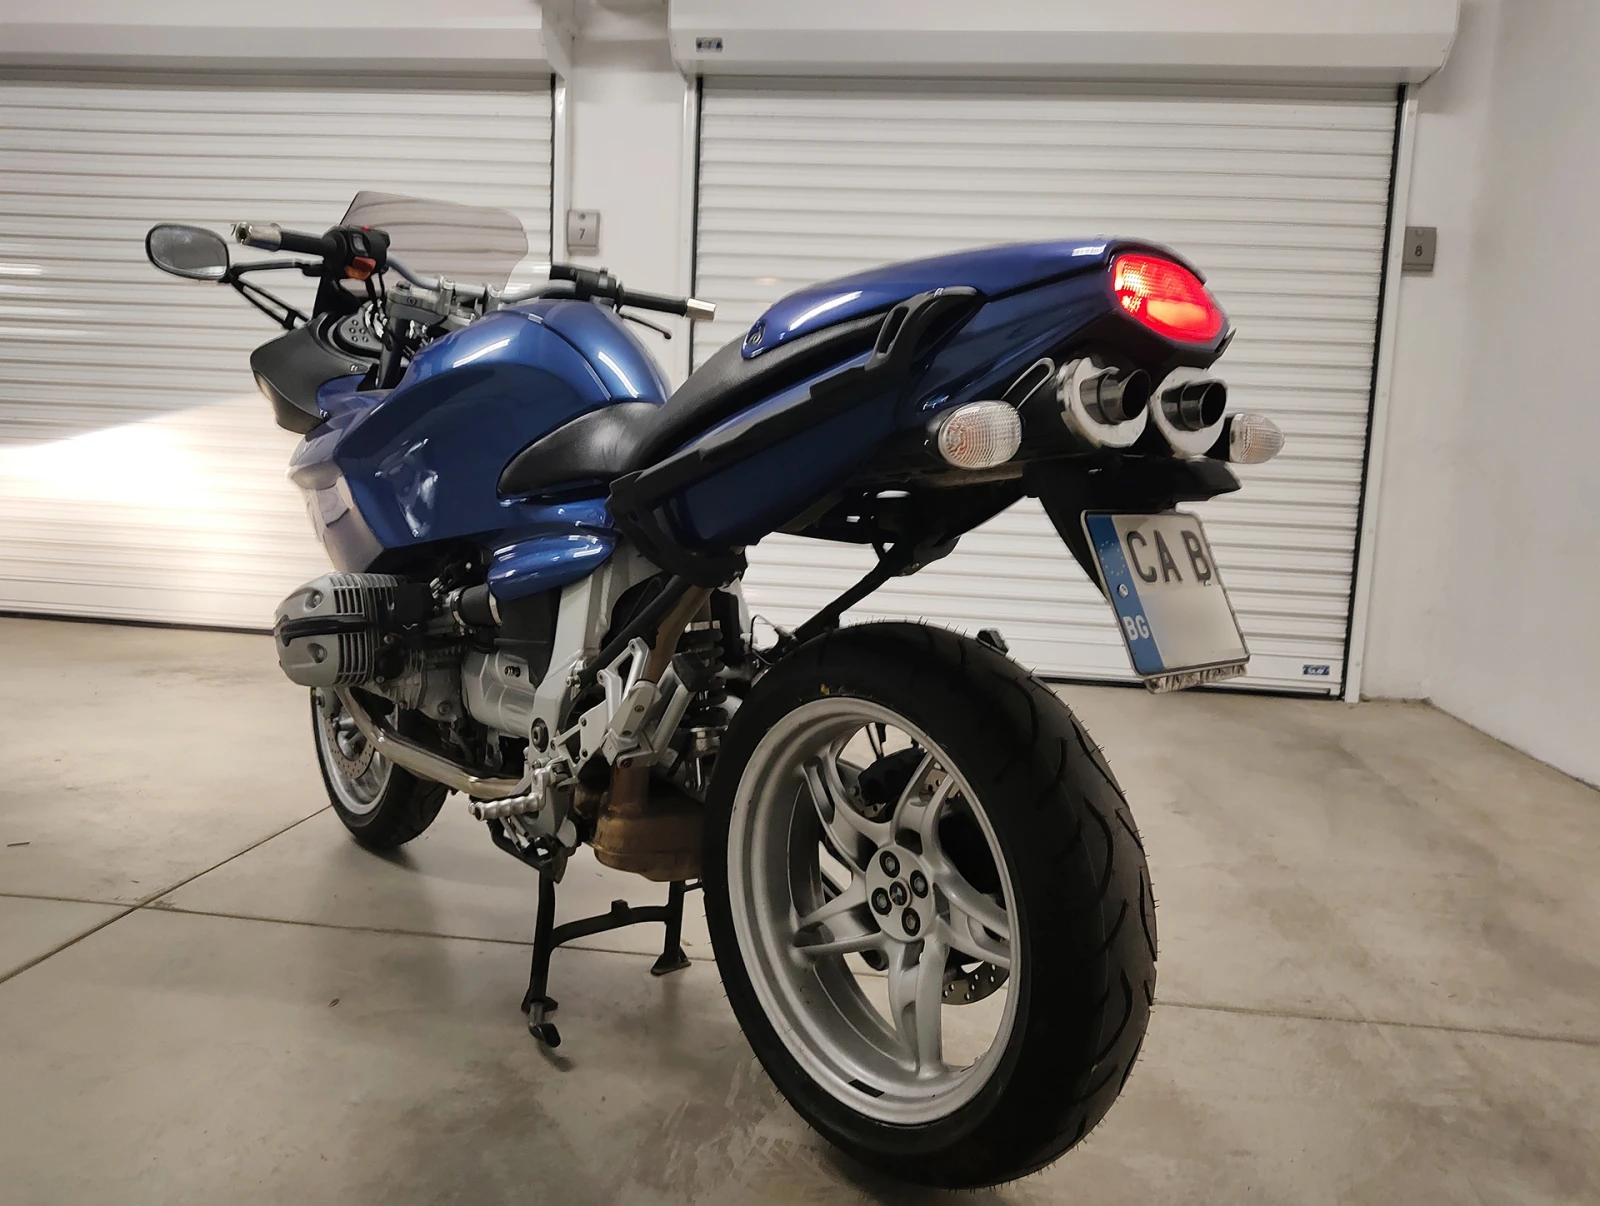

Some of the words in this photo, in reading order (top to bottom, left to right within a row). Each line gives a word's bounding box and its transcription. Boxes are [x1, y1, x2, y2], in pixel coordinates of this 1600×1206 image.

[579, 228, 586, 240] 7
[1414, 244, 1423, 257] 8
[1126, 530, 1183, 583] CA
[1180, 530, 1212, 582] B
[1122, 615, 1150, 641] BG
